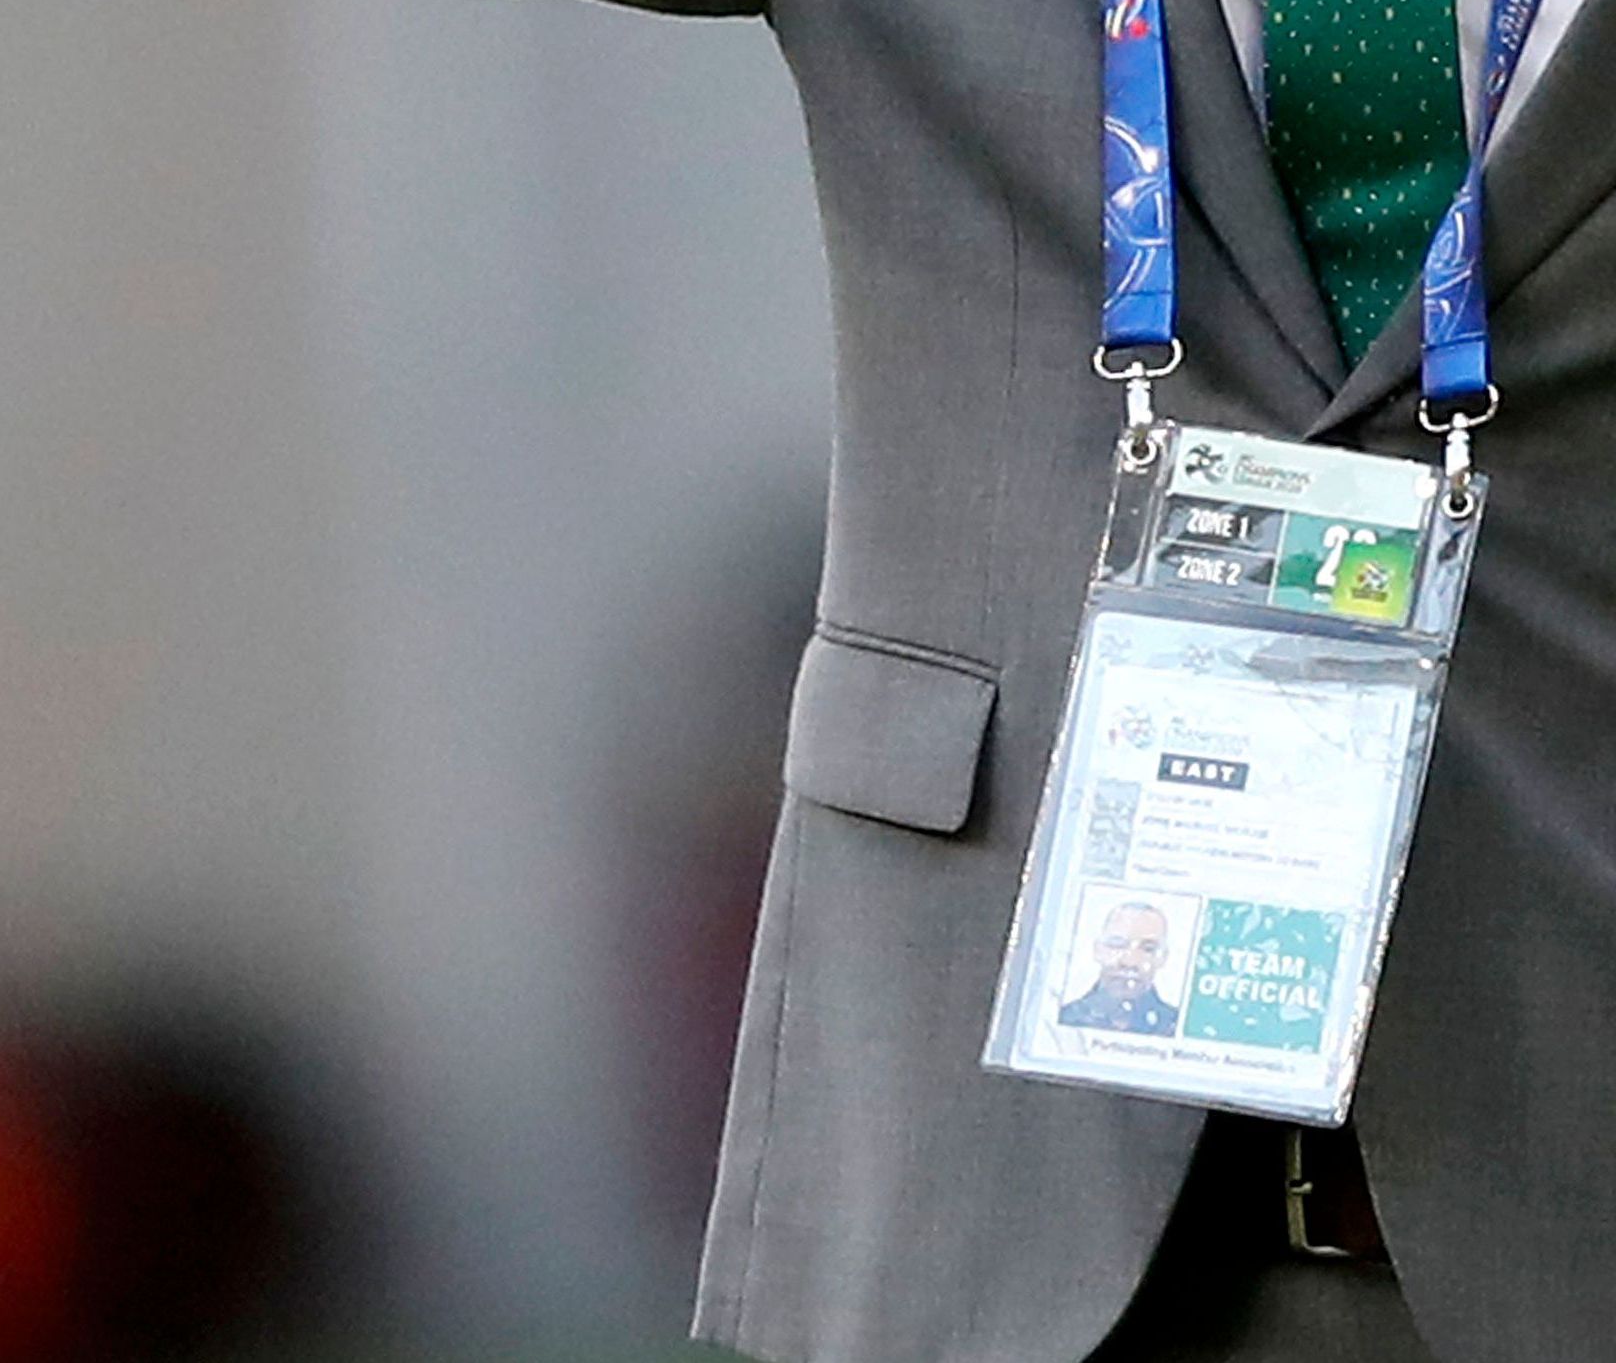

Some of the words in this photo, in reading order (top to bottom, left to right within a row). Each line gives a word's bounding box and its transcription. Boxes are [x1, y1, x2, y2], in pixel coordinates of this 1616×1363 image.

[1186, 508, 1233, 537] ZONE
[1238, 514, 1250, 538] 1
[1177, 555, 1225, 584] ZONE
[1225, 562, 1243, 585] 2
[1170, 759, 1235, 783] EAST
[1228, 947, 1307, 980] TEAM
[1198, 973, 1324, 1009] OFFICIAL
